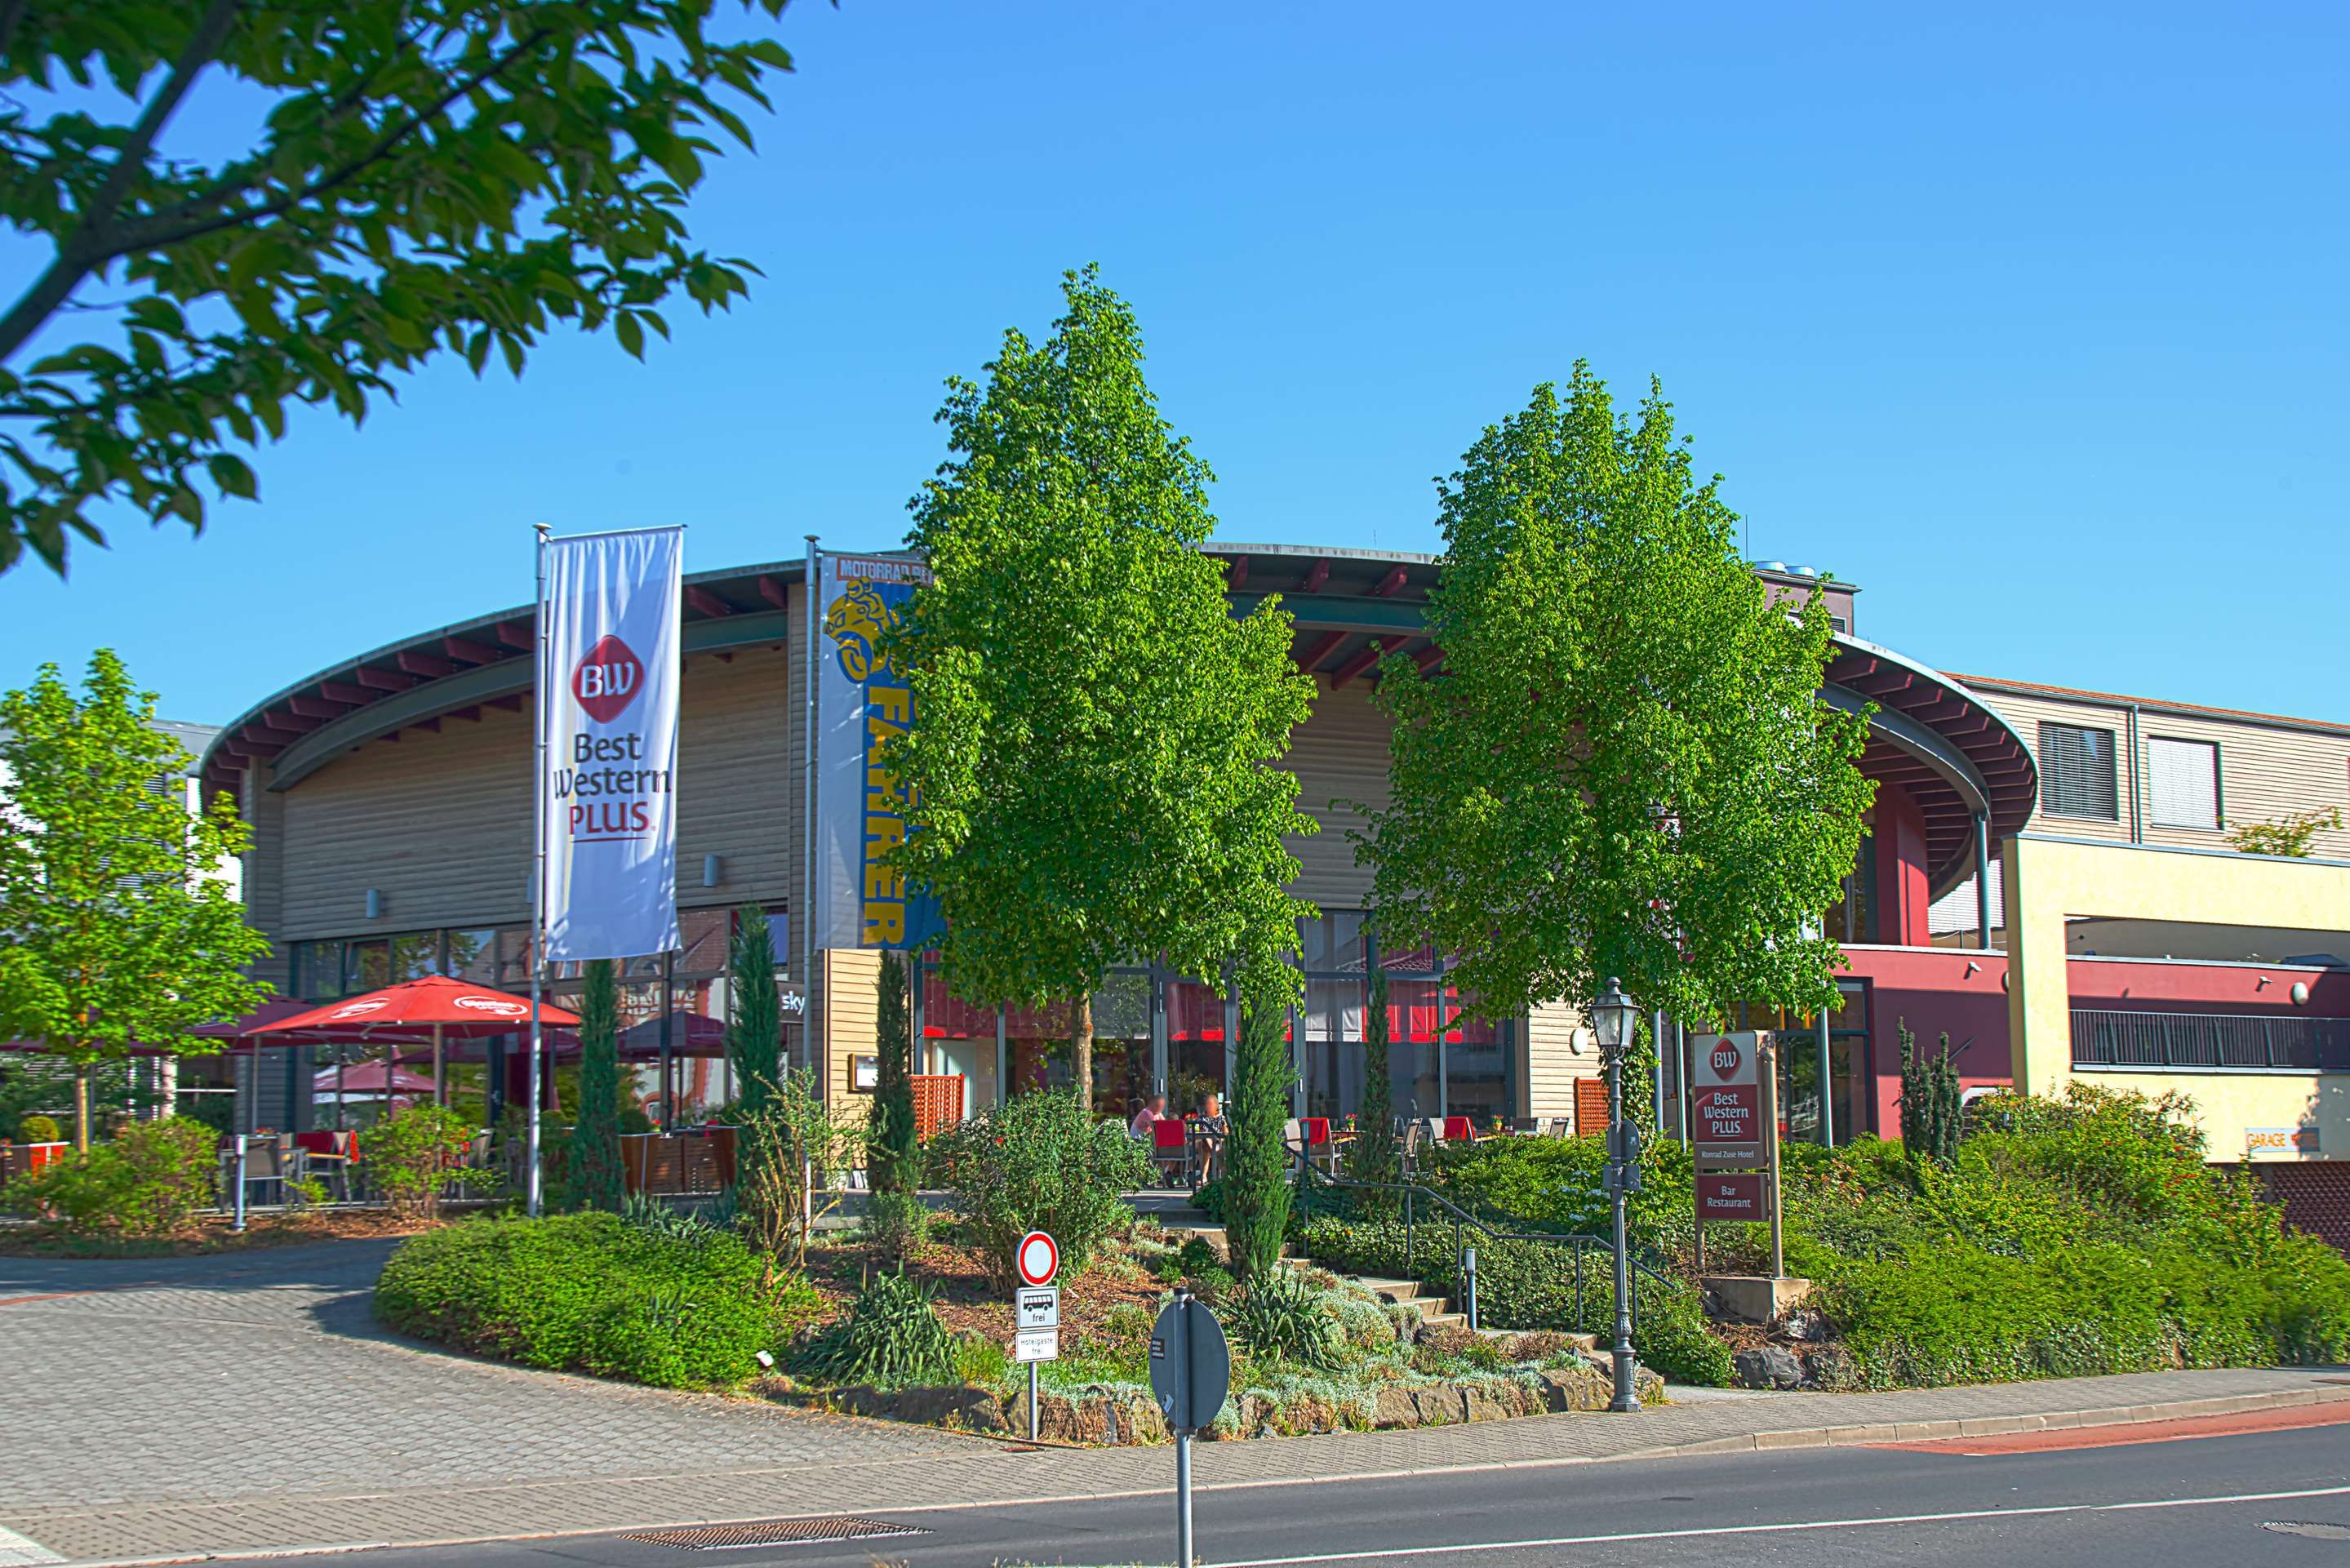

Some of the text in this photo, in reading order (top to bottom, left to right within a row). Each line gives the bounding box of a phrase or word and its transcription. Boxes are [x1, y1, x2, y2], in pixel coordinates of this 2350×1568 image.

[840, 560, 909, 580] MOTORRAD
[580, 662, 635, 698] BW
[575, 733, 642, 763] Best
[553, 766, 671, 799] Western
[570, 802, 650, 835] PLUS
[781, 990, 806, 1015] sky
[1714, 1051, 1737, 1068] BW
[1714, 1092, 1738, 1105] Best
[1704, 1106, 1748, 1118] Western
[1713, 1120, 1741, 1134] PLUS
[2246, 1132, 2286, 1147] GARAGE
[1702, 1149, 1754, 1158] Konrad Zuse Hotel
[1721, 1185, 1735, 1196] Bar
[1707, 1197, 1751, 1208] Restaurant
[1033, 1313, 1046, 1322] frei
